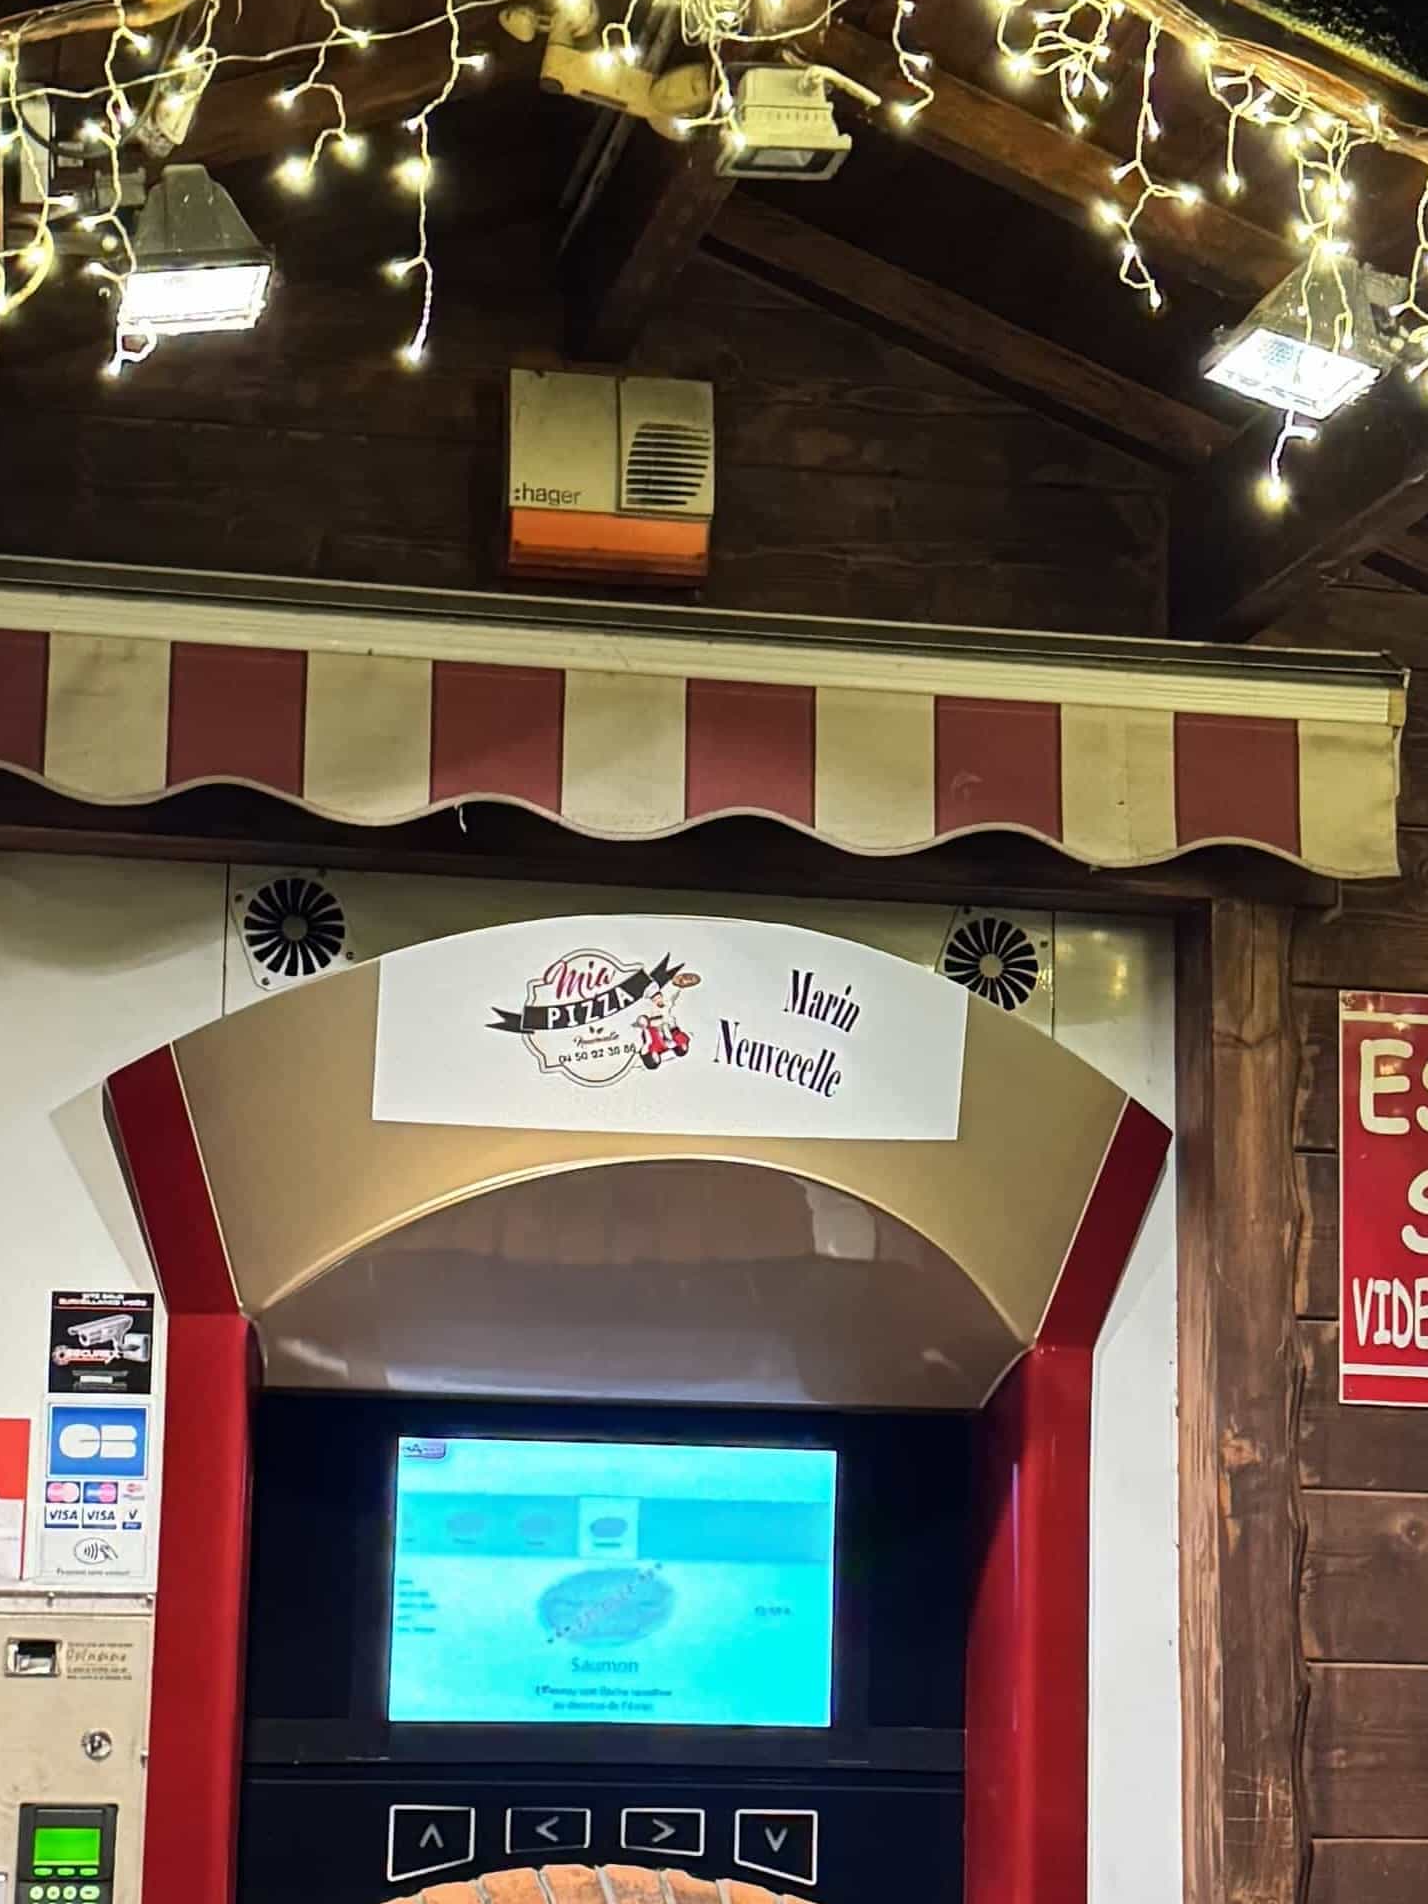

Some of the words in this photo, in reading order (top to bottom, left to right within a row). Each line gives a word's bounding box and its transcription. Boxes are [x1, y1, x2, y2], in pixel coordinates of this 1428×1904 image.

[544, 959, 616, 999] Mia
[548, 987, 634, 1028] PIZZA
[783, 969, 860, 1032] Marin
[713, 1018, 841, 1097] Neuvecelle
[50, 1509, 78, 1521] VISA
[87, 1510, 116, 1522] VISA
